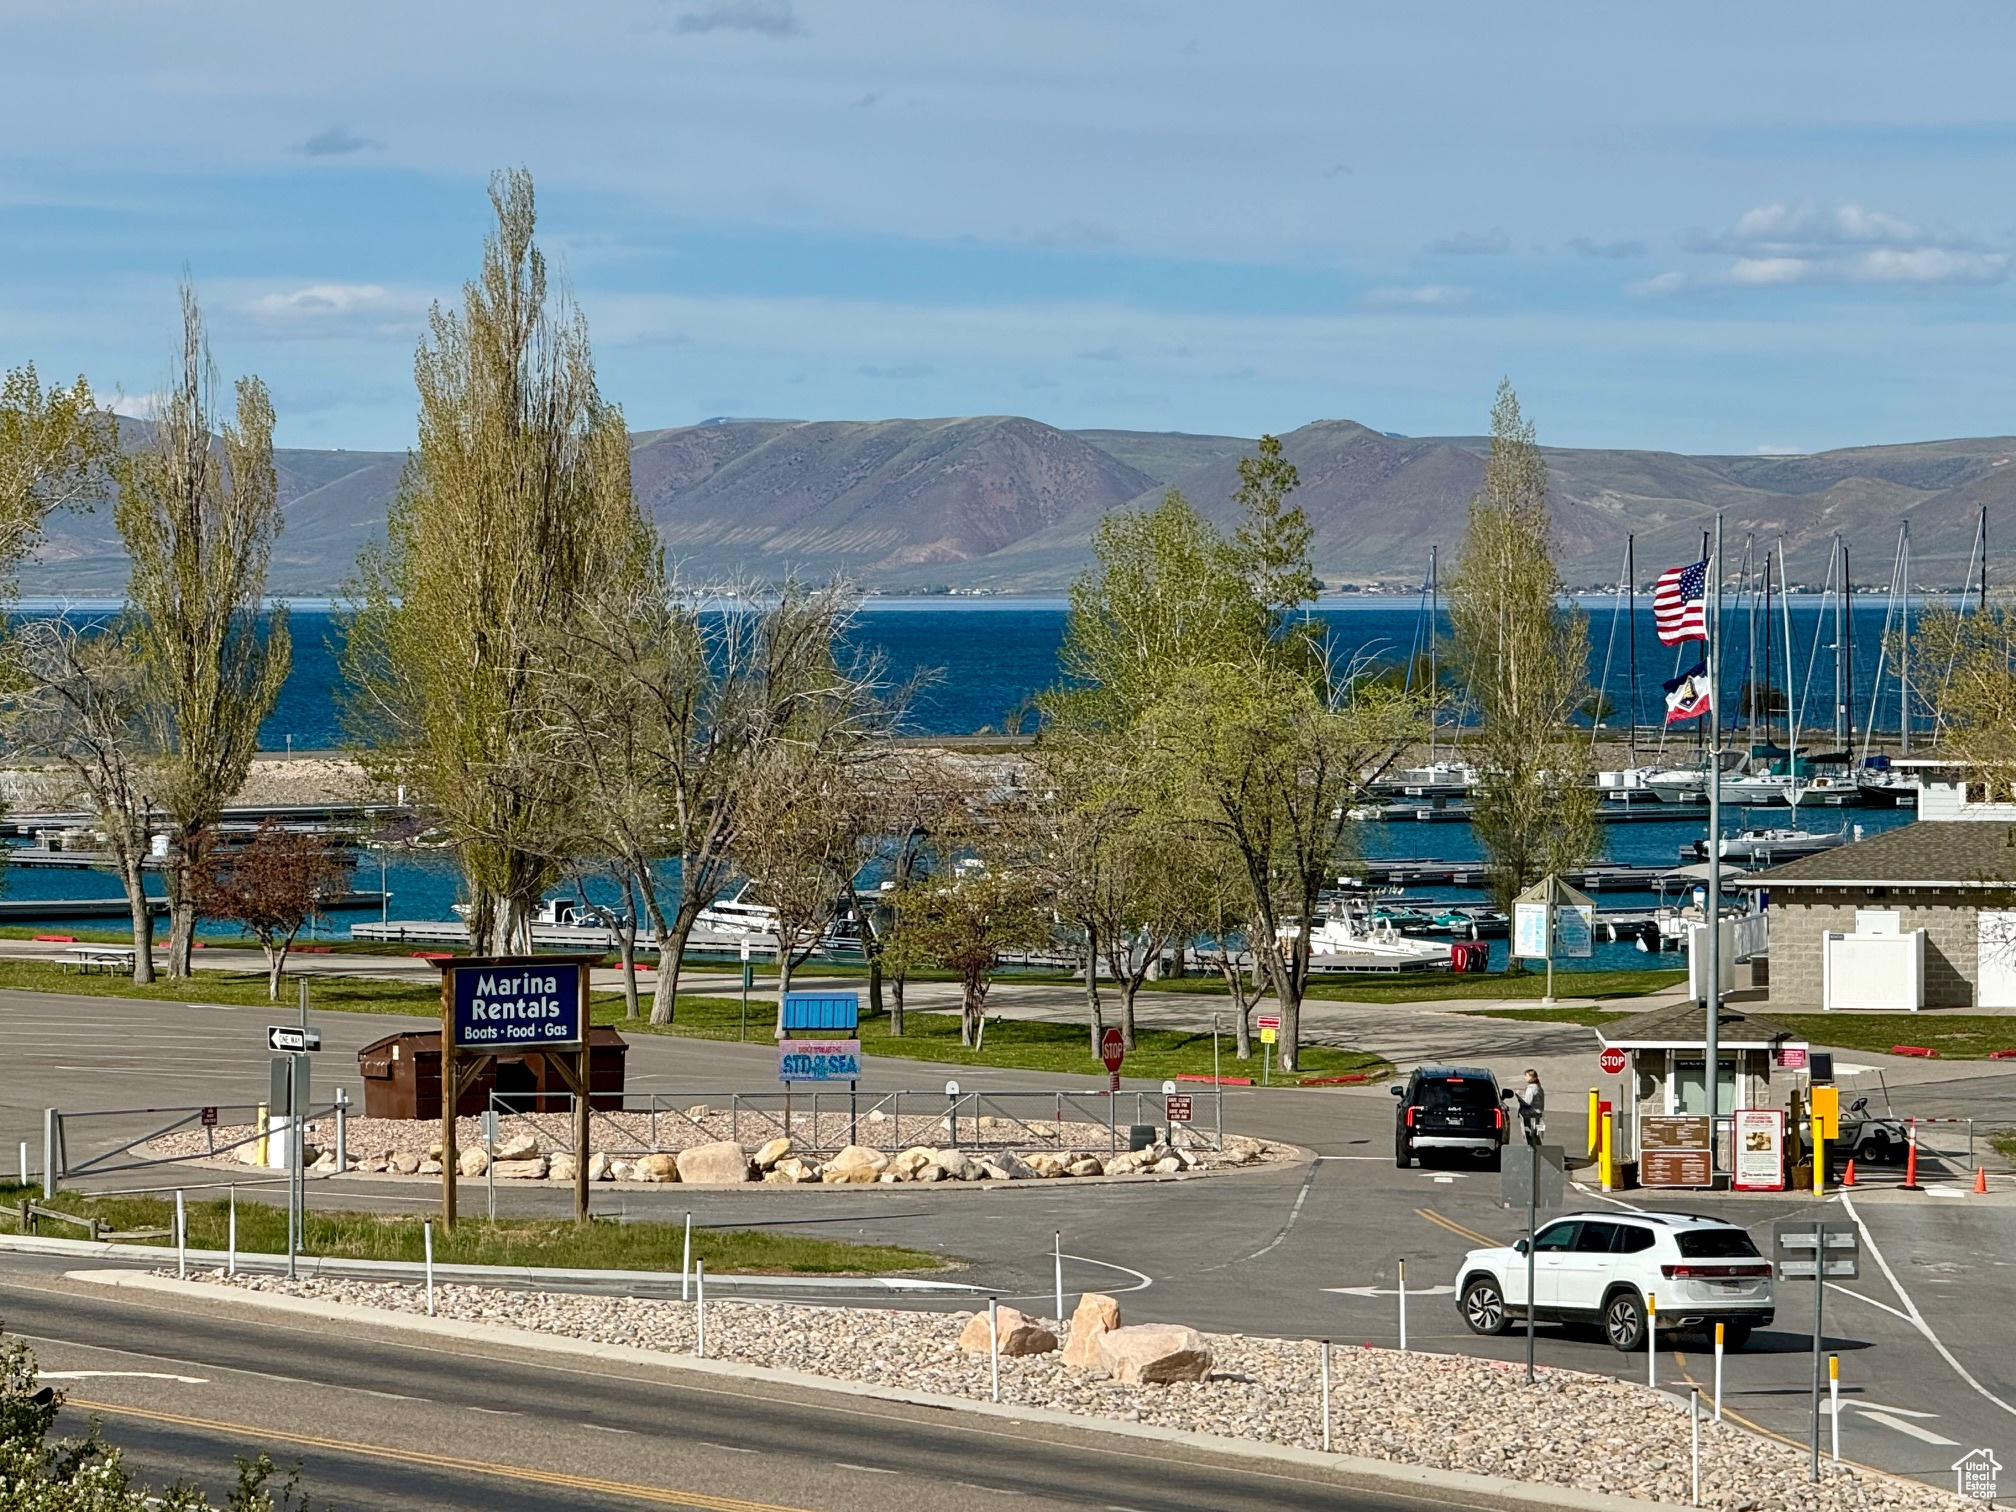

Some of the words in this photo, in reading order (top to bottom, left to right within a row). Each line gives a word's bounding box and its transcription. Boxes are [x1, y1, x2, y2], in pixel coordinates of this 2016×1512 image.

[476, 972, 557, 997] Marina
[472, 996, 560, 1020] Rentals
[279, 1034, 290, 1044] ONE
[290, 1036, 301, 1044] WAY
[464, 1025, 498, 1039] Boats
[507, 1023, 535, 1038] Food
[544, 1022, 568, 1037] Gas
[1104, 1042, 1122, 1059] STOP
[828, 1054, 858, 1074] SEA
[1601, 1056, 1625, 1067] STOP
